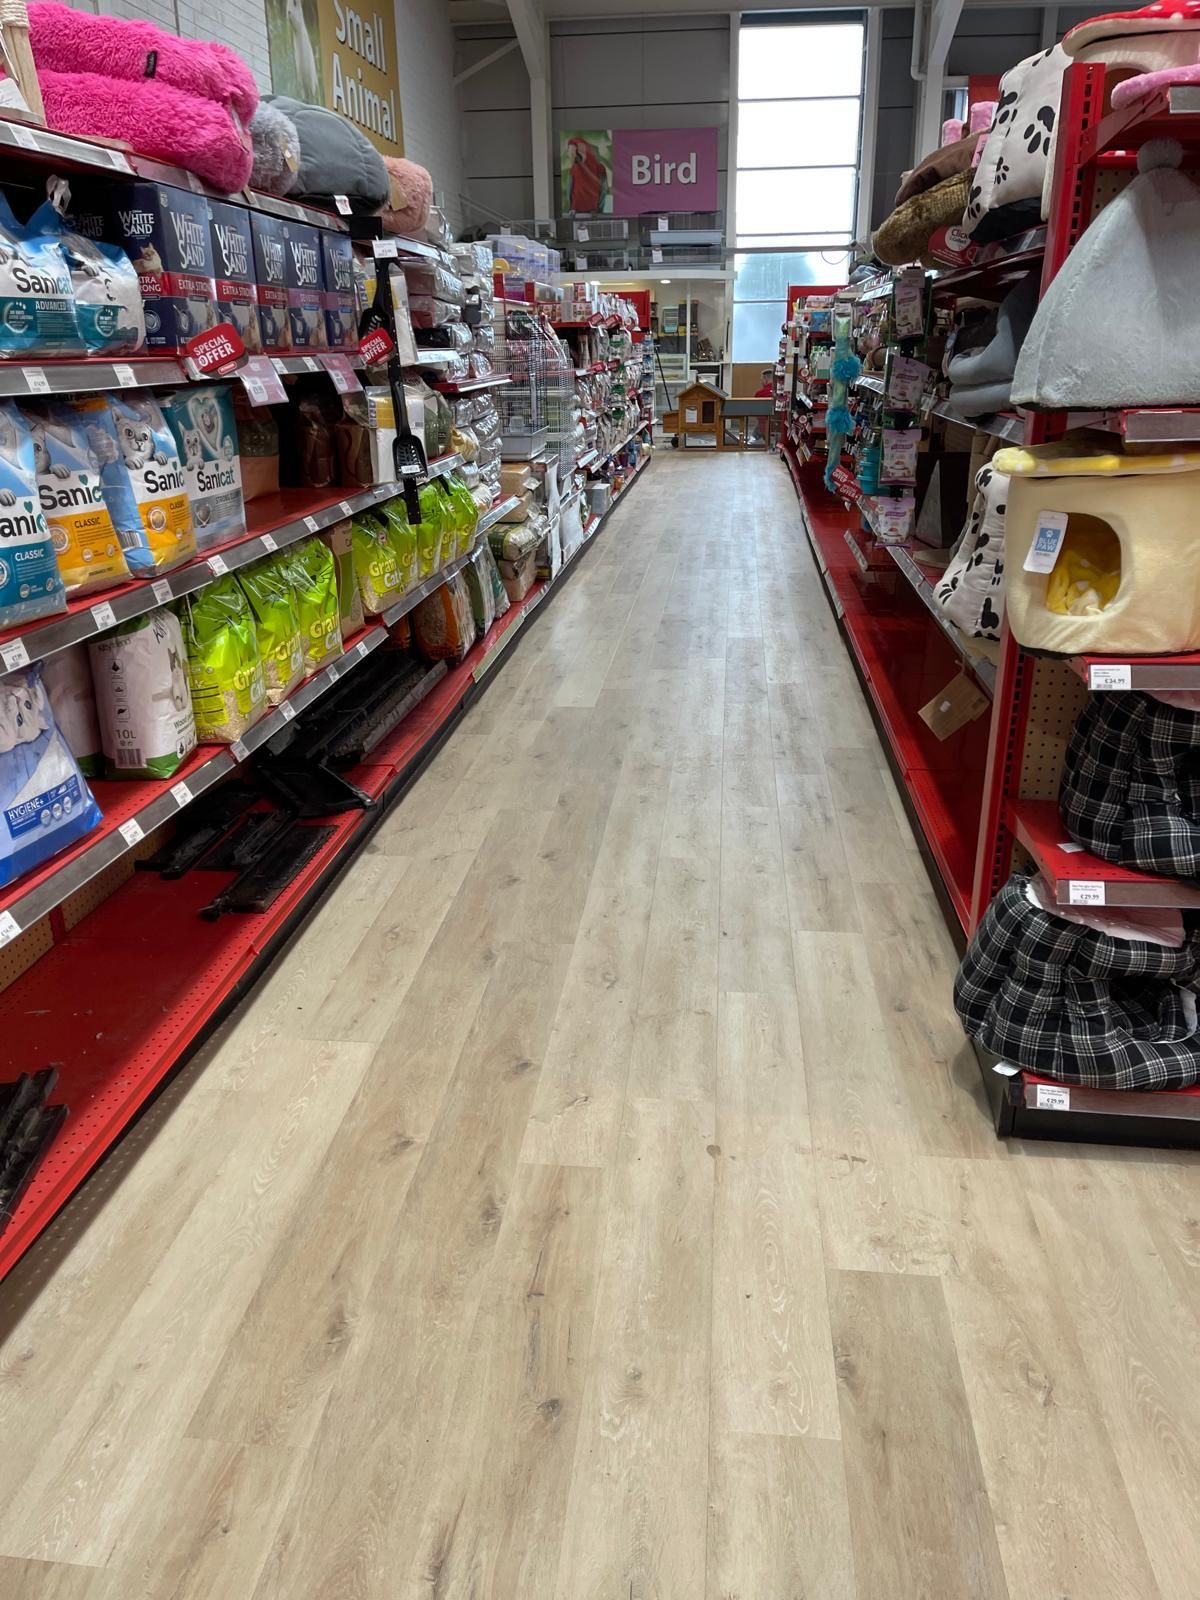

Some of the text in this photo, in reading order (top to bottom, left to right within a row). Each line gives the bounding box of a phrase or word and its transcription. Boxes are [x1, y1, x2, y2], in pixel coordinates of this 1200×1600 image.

[333, 0, 386, 74] Small
[332, 52, 398, 143] Animal
[631, 152, 697, 185] Bird
[118, 210, 155, 225] WHITE
[170, 211, 205, 247] WHITE
[124, 223, 154, 237] SAND
[214, 223, 247, 255] WHITE
[178, 240, 206, 270] SAND
[221, 248, 248, 276] SAND
[290, 241, 318, 267] WHITE
[12, 267, 74, 295] Sanicat
[265, 258, 283, 282] SAND
[295, 263, 318, 286] SAND
[334, 270, 351, 290] SAND
[178, 279, 195, 291] EXTRA
[222, 285, 239, 296] EXTRA
[35, 300, 67, 311] ADVANCED
[193, 334, 229, 356] SPECIAL
[198, 342, 235, 367] OFFER
[361, 336, 383, 353] SPECIAL
[365, 341, 388, 360] OFFER
[197, 466, 236, 492] Sanicat
[0, 513, 48, 538] anic
[74, 516, 101, 529] CLASSIC
[15, 548, 45, 562] CLASSIC
[115, 729, 137, 740] 10L
[8, 797, 44, 820] HYGIENE+
